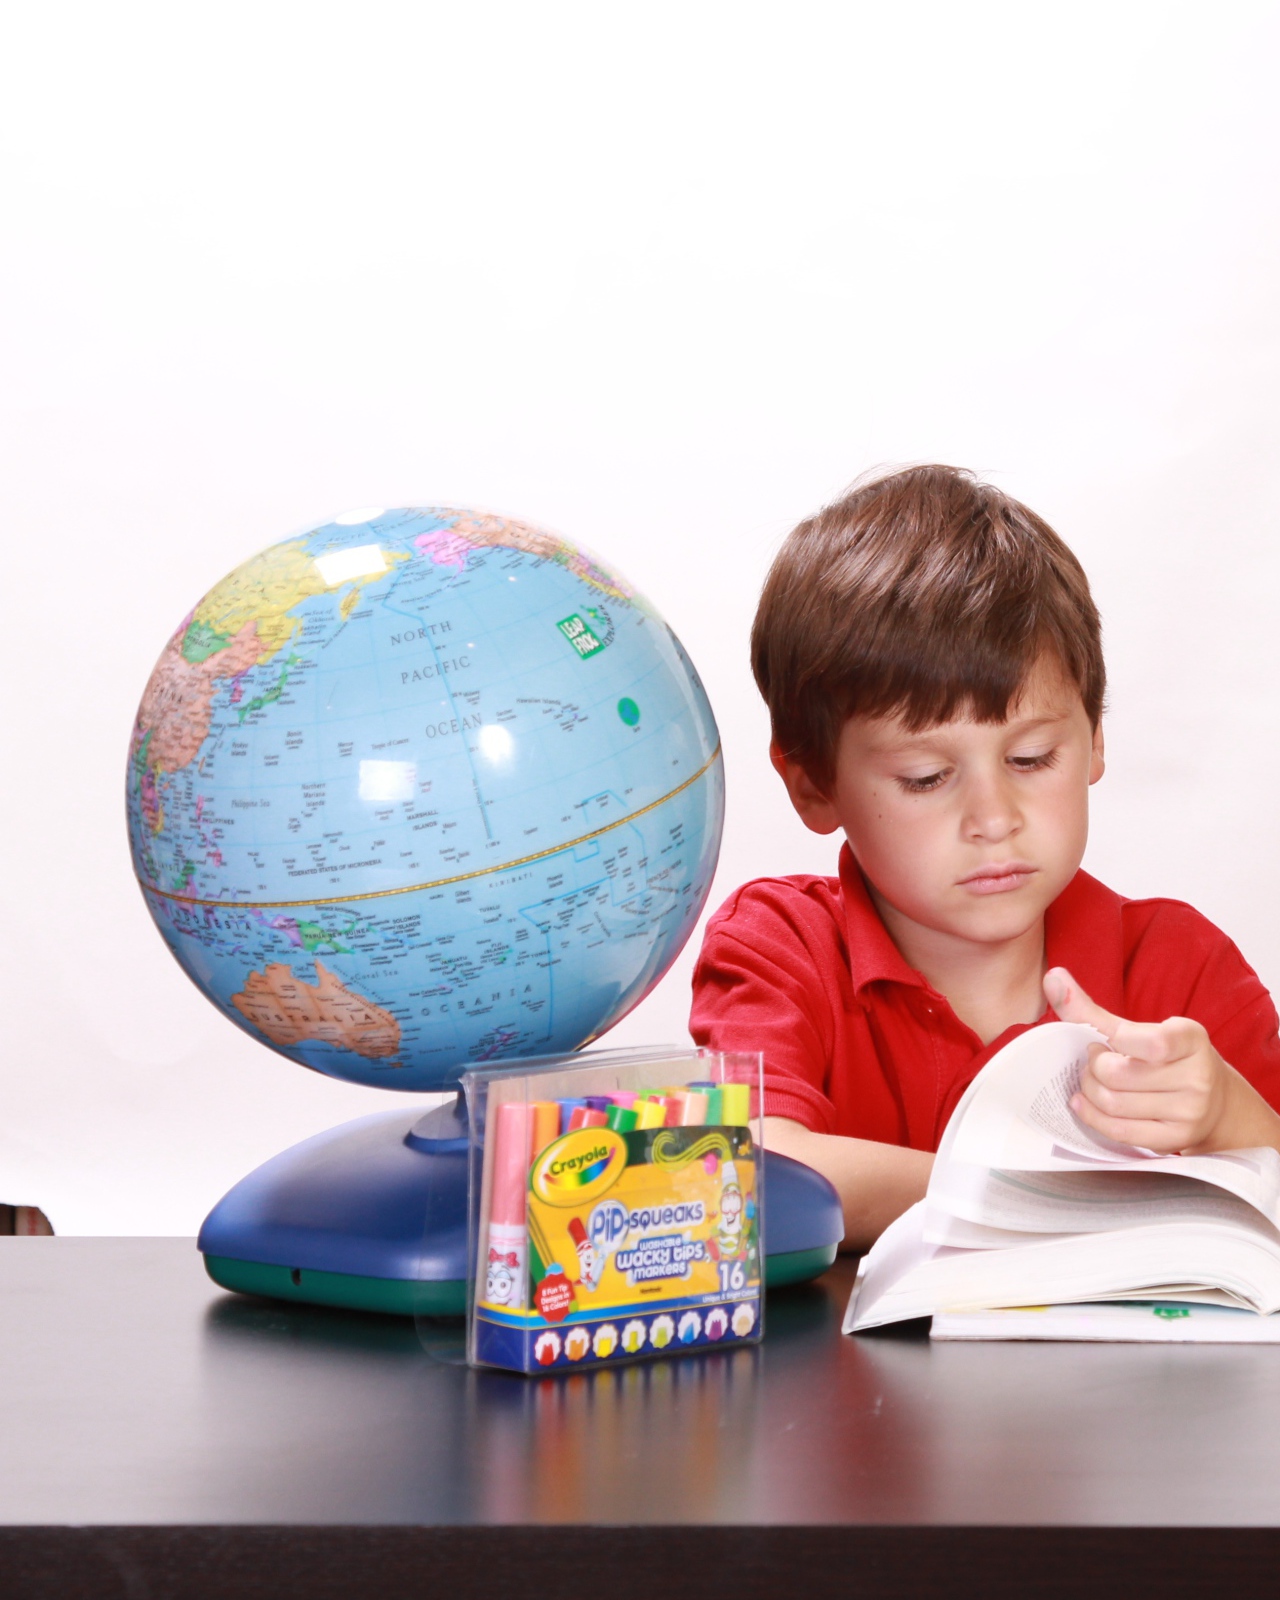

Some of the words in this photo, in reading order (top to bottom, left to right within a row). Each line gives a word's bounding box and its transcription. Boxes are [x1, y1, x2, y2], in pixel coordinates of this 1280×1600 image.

[390, 620, 452, 646] NORTH
[560, 617, 586, 640] LEAP
[572, 632, 600, 656] FROG
[401, 655, 471, 685] PACIFIC
[425, 713, 483, 739] OCEAN
[412, 820, 438, 831] ISLANDS
[288, 868, 318, 877] FEDERATED
[319, 865, 338, 874] STATES
[347, 859, 382, 870] MICRONESIA
[489, 872, 533, 889] KIRIBATI
[392, 914, 421, 924] SOLOMON
[396, 921, 421, 930] ISLANDS
[327, 930, 342, 938] NEW
[344, 928, 370, 936] GUINEA
[354, 971, 379, 981] Coral
[383, 969, 399, 978] Sea
[421, 984, 532, 1017] OCEANIA
[249, 1012, 372, 1024] AUSTRALIA
[550, 1146, 608, 1176] Crayola
[719, 1261, 745, 1292] 16
[547, 1287, 558, 1296] Fun
[558, 1283, 568, 1293] Tip
[540, 1293, 564, 1306] Designs
[563, 1291, 571, 1299] in
